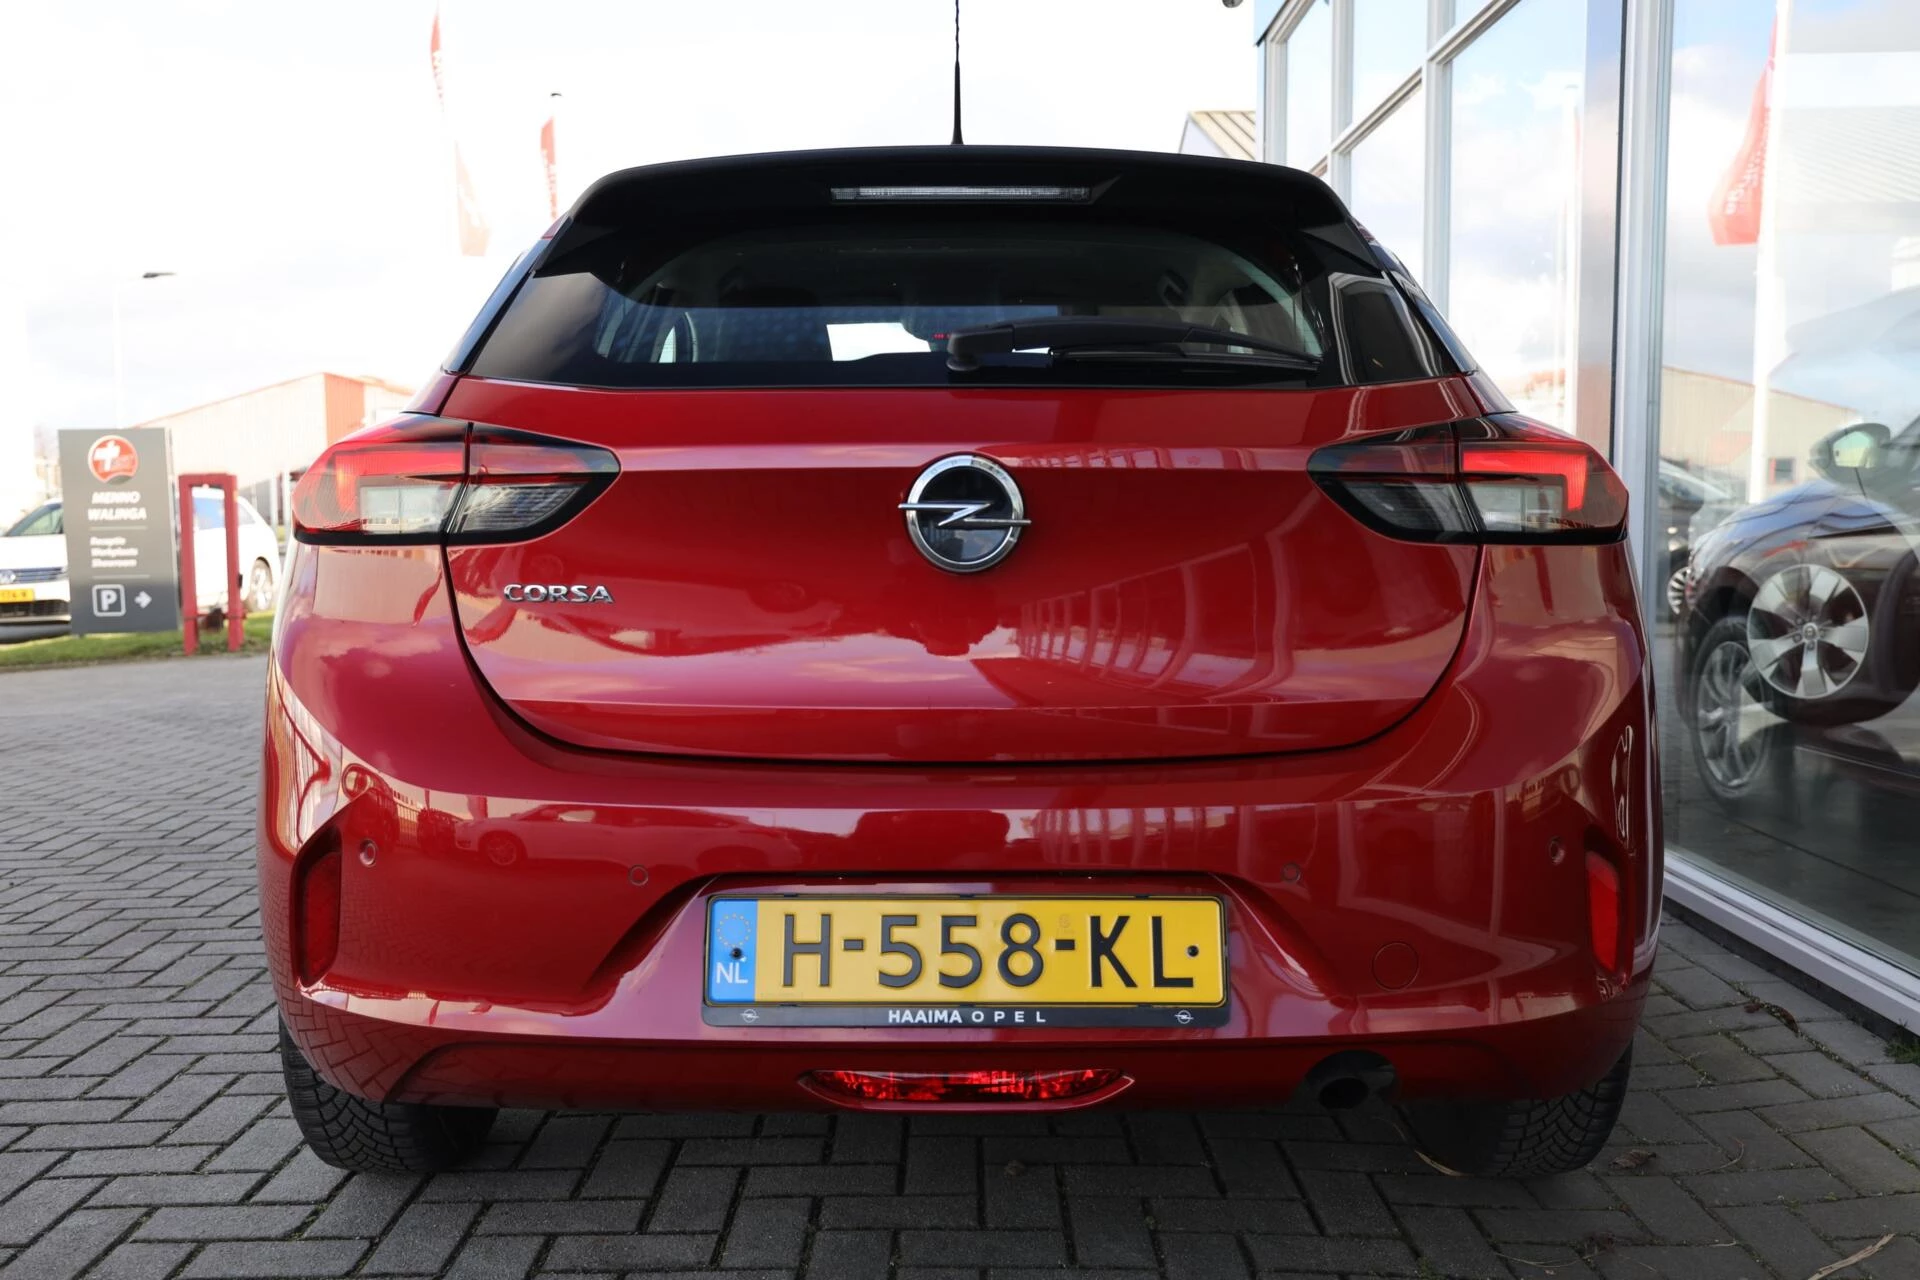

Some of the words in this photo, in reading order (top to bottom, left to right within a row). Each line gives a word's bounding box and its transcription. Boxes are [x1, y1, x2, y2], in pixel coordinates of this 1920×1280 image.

[100, 589, 117, 611] P
[503, 583, 614, 603] CORSA
[782, 913, 1195, 988] H-558-KL
[715, 961, 749, 984] NL
[888, 1009, 963, 1024] HAAIMA
[971, 1010, 1047, 1023] OPEL
